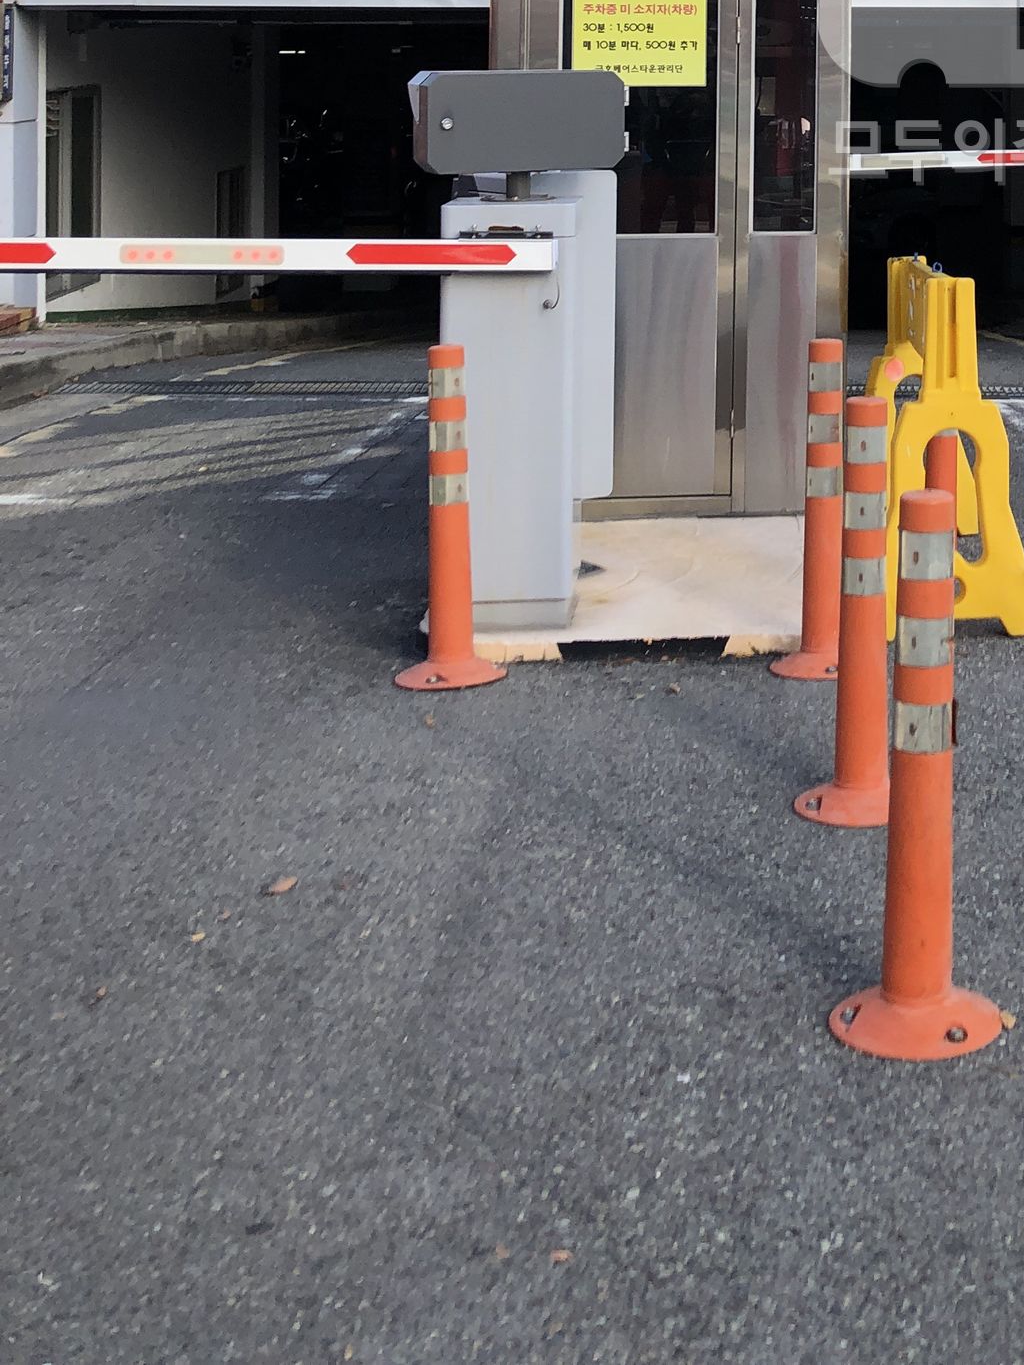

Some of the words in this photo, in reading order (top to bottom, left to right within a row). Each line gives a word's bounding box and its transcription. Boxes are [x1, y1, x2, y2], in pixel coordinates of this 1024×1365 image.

[620, 4, 631, 16] 미
[633, 3, 698, 16] 소지자(차량)
[583, 22, 605, 33] 30분
[616, 22, 654, 34] 1,500원
[596, 40, 617, 51] 10분
[645, 40, 676, 51] 500원
[680, 40, 698, 51] 추가
